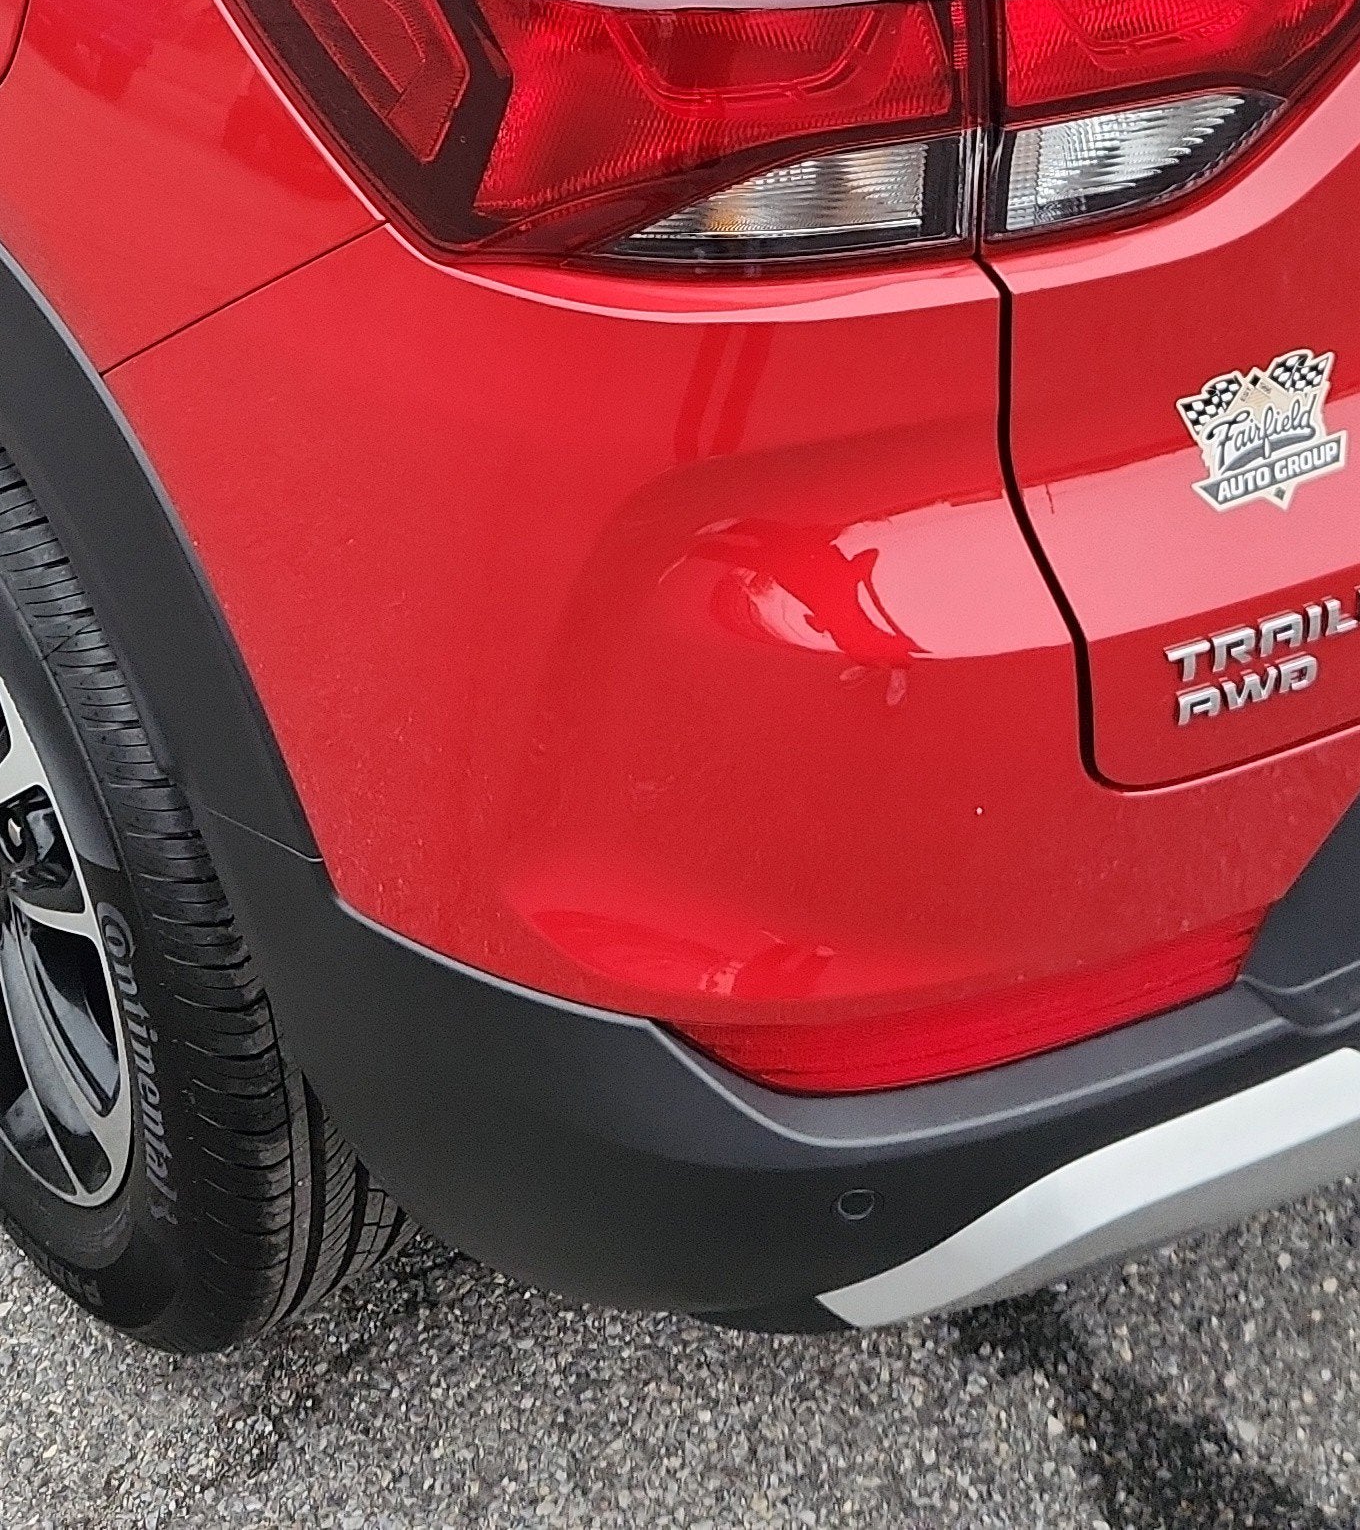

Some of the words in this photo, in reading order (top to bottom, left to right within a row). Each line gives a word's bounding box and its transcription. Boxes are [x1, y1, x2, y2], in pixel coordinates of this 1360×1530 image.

[1206, 393, 1317, 471] Fairfield
[1217, 469, 1271, 503] AUTO
[1274, 441, 1339, 480] GROUP
[1177, 652, 1319, 727] AWD
[96, 901, 178, 1203] Continental
